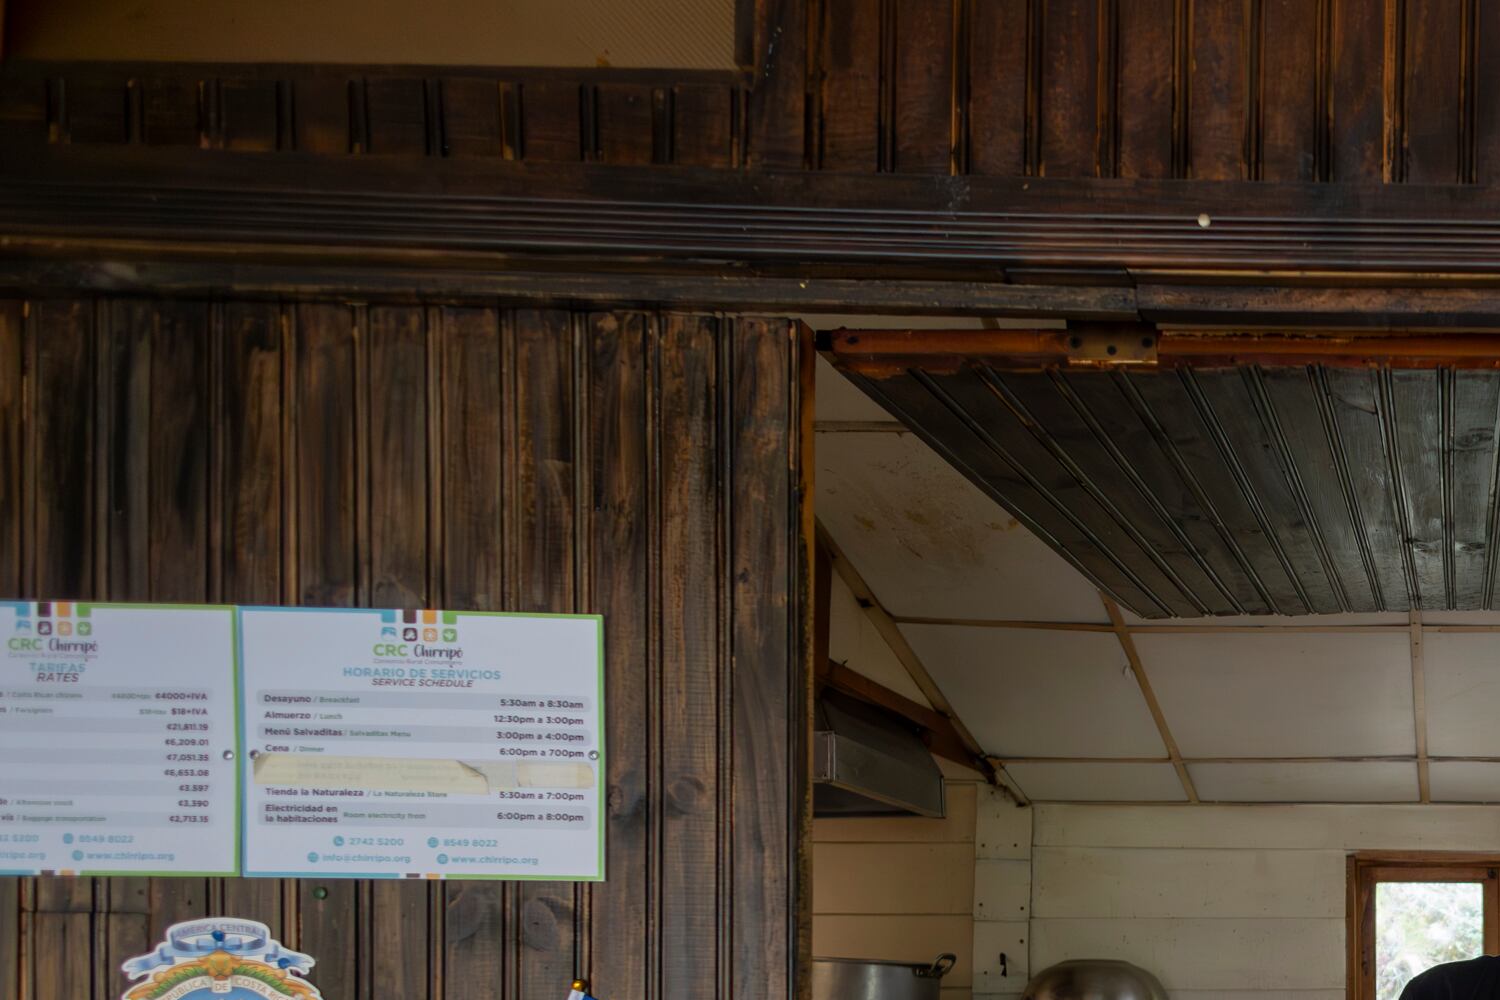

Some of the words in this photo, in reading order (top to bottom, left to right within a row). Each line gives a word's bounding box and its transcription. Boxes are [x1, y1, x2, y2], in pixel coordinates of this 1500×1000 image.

[8, 638, 43, 651] CRC
[373, 643, 408, 657] CRC
[36, 672, 80, 683] RATES
[343, 666, 406, 678] HORARIO
[409, 667, 428, 678] DE
[431, 668, 502, 681] SERVICIOS
[371, 678, 416, 687] SERVICE
[418, 679, 474, 688] SCHEDULE
[264, 694, 312, 704] Desayuno
[500, 698, 537, 708] 5:30am
[546, 700, 584, 709] 8:30am
[264, 711, 312, 720] Almuerzo
[494, 715, 536, 724] 12:30pm
[546, 716, 584, 725] 3:00pm
[294, 728, 343, 736] Salvaditas
[496, 731, 535, 741] 3:00pm
[545, 733, 585, 742] 4:00pm
[264, 744, 290, 752] Cena
[499, 748, 538, 757] 6:00pm
[265, 788, 299, 796] Tienda
[301, 788, 310, 796] la
[312, 789, 365, 797] Naturaleza
[499, 791, 536, 800] 5:30am
[546, 792, 584, 801] 7:00pm
[265, 803, 324, 812] Electricidad
[326, 805, 339, 813] en
[265, 814, 274, 822] la
[277, 814, 339, 823] habitaciones
[497, 812, 536, 822] 6:00pm
[546, 813, 584, 823] 8:00pm
[350, 837, 375, 846] 2742
[377, 837, 405, 847] 5200
[322, 853, 412, 864] info@chirripo.org
[451, 854, 539, 866] www.chirripo.org
[214, 983, 229, 992] DE
[235, 978, 267, 996] COSTA
